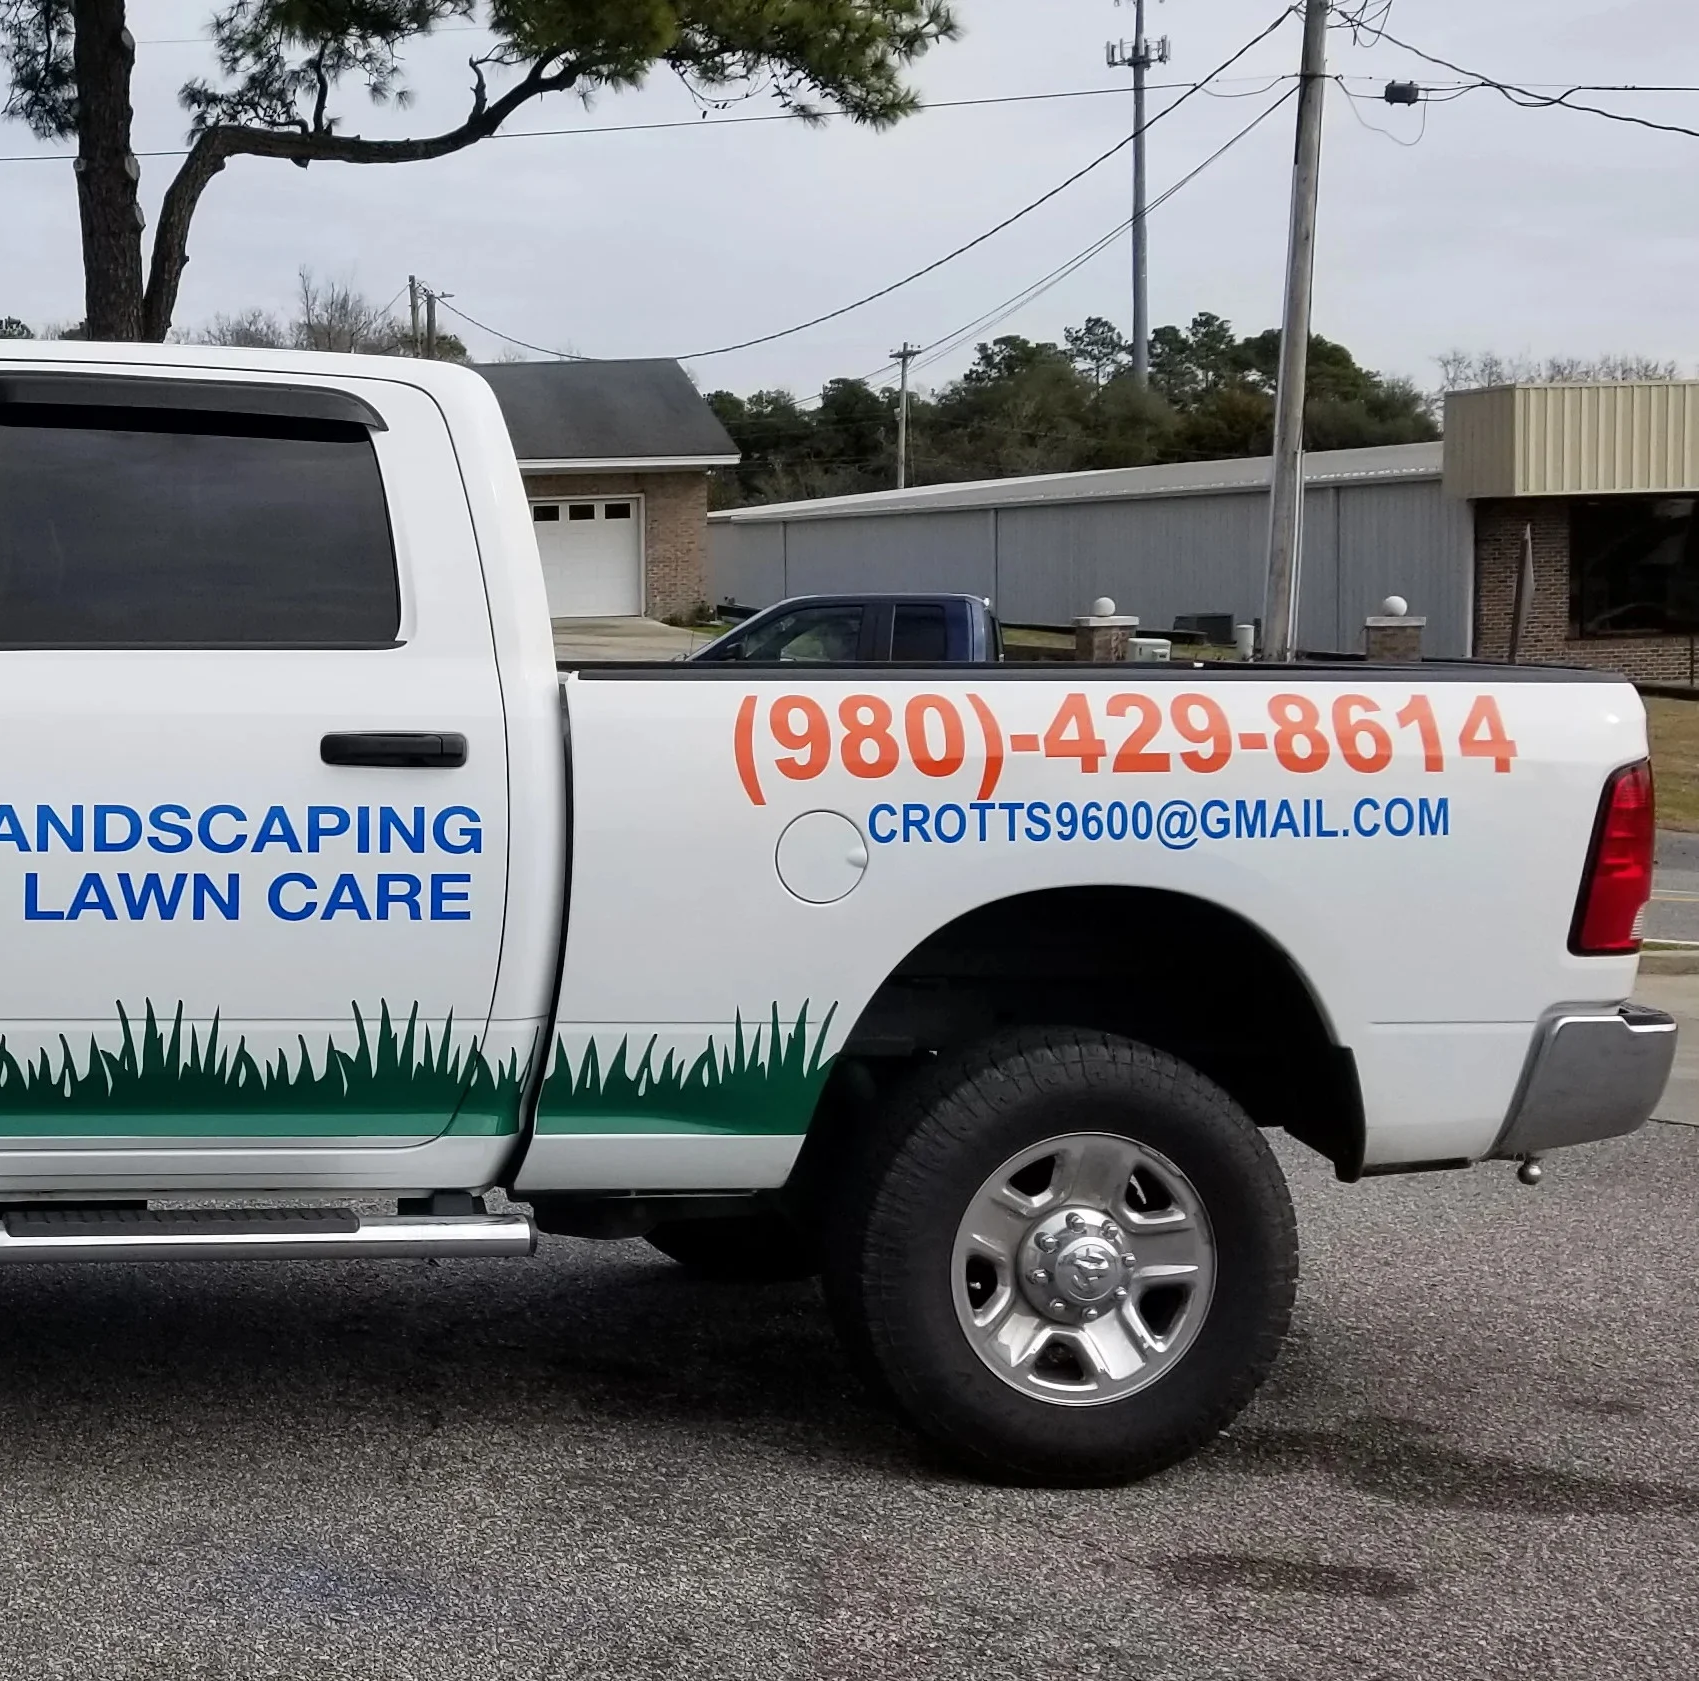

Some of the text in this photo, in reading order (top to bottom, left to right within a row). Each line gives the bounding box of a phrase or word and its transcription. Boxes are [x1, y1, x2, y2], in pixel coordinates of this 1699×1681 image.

[734, 692, 1516, 806] (980)-429-8614
[868, 797, 1450, 850] CROTTS9600@GMAIL.COM
[24, 873, 240, 920] LAWN
[267, 872, 472, 921] CARE
